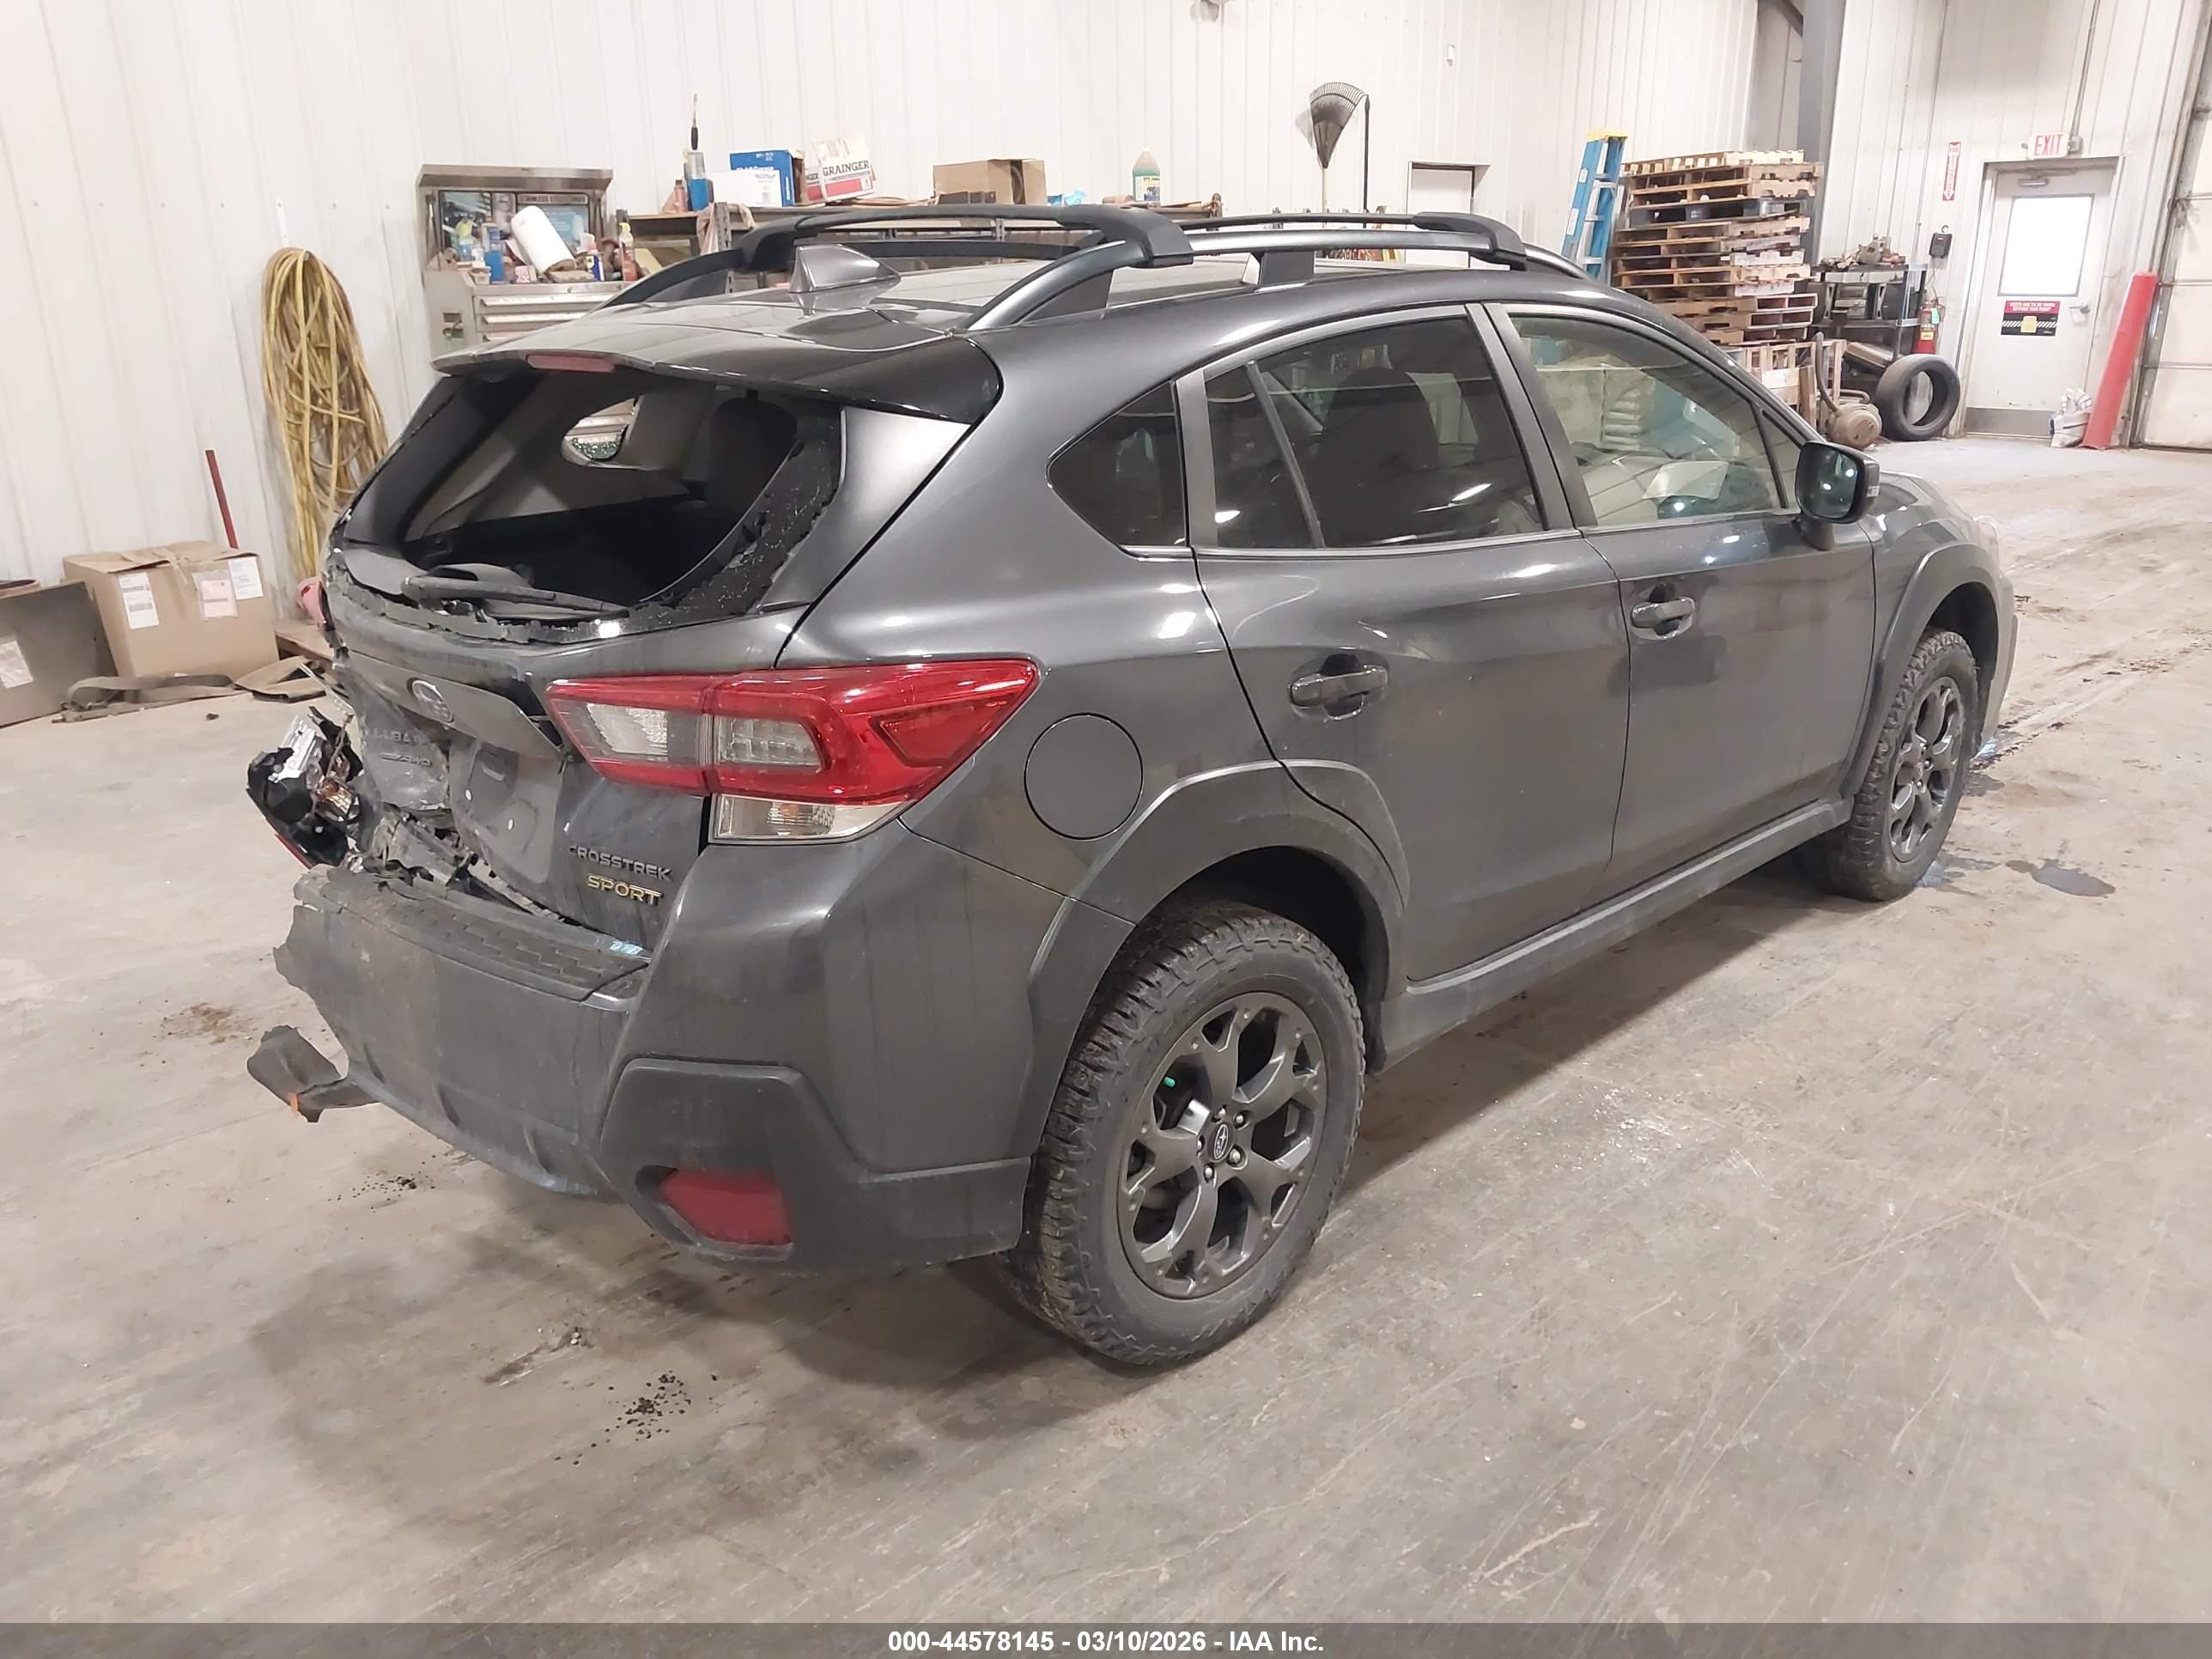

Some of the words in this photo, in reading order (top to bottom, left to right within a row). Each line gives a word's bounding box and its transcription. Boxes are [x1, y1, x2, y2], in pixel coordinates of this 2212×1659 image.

[2034, 134, 2063, 155] EXIT
[823, 160, 870, 176] GRAINGER
[569, 845, 672, 880] CROSSTREK
[587, 873, 663, 906] SPORT
